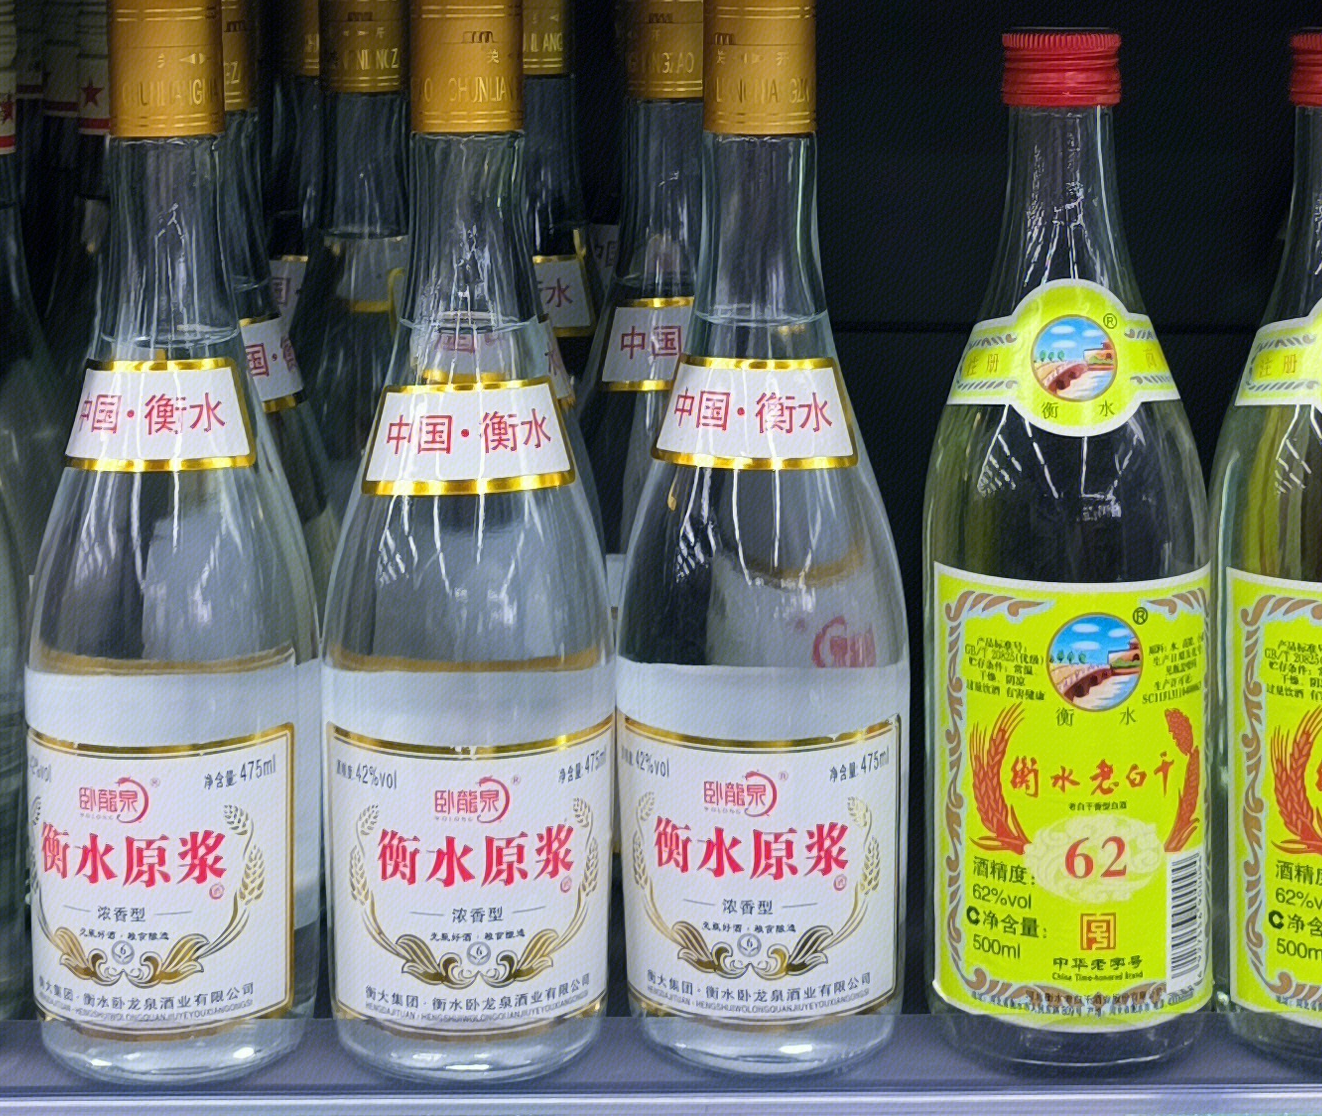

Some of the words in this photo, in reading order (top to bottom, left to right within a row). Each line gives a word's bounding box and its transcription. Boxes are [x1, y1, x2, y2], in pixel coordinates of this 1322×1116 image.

[671, 389, 835, 438] 中国·衡水
[384, 408, 554, 456] 中国·衡水
[239, 754, 277, 781] 475ml
[860, 747, 890, 772] 475ml
[1010, 750, 1175, 798] 衡水老白干
[41, 822, 227, 888] 衡水原浆
[377, 823, 574, 888] 衡水原浆
[654, 816, 849, 880] 衡水原浆
[1064, 836, 1128, 879] 62
[722, 899, 774, 916] 浓香型
[972, 883, 1033, 911] 62%vol
[97, 905, 146, 923] 浓香型
[451, 906, 505, 924] 浓香型
[972, 937, 1021, 960] 500ml
[1053, 955, 1144, 972] 中华老字号
